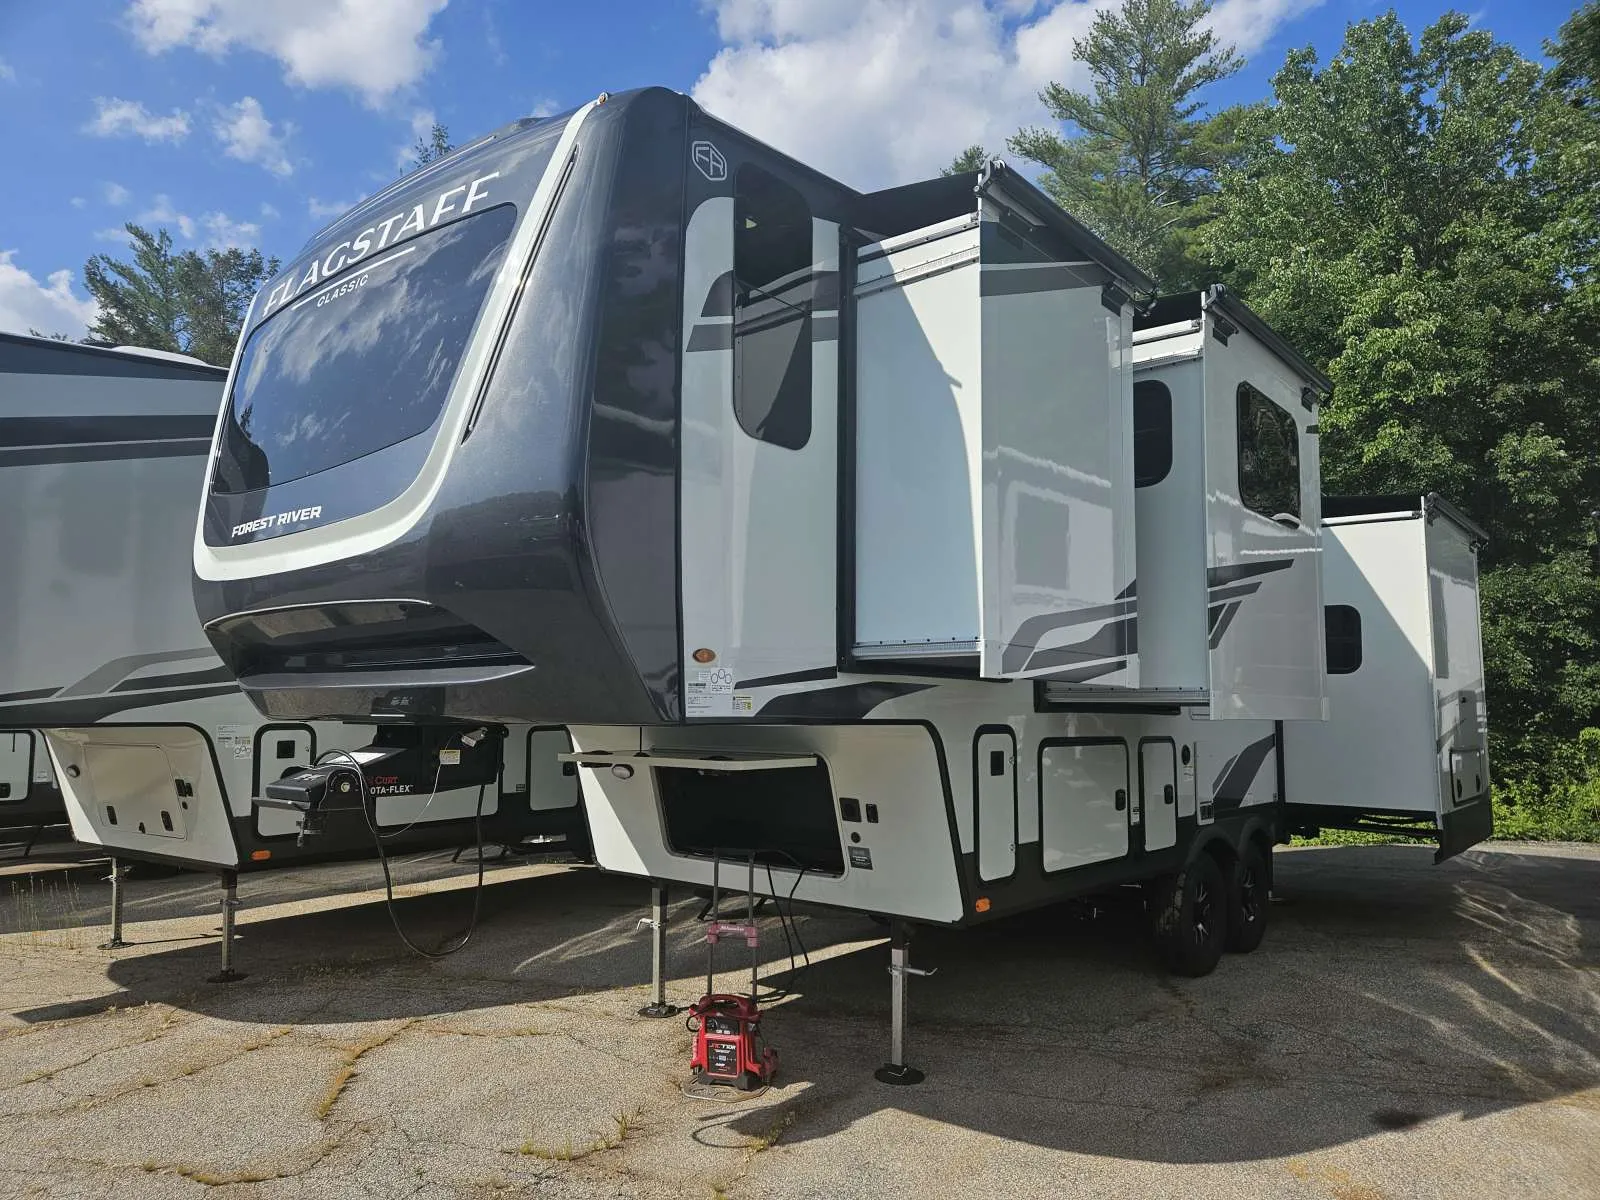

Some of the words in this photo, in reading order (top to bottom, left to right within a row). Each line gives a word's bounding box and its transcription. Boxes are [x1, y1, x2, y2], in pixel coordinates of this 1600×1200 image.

[262, 171, 500, 317] FLAGSTAFF
[316, 273, 369, 307] CLASSIC
[231, 515, 276, 538] FOREST
[276, 505, 322, 526] RIVER
[370, 784, 410, 795] OTA-FLEX
